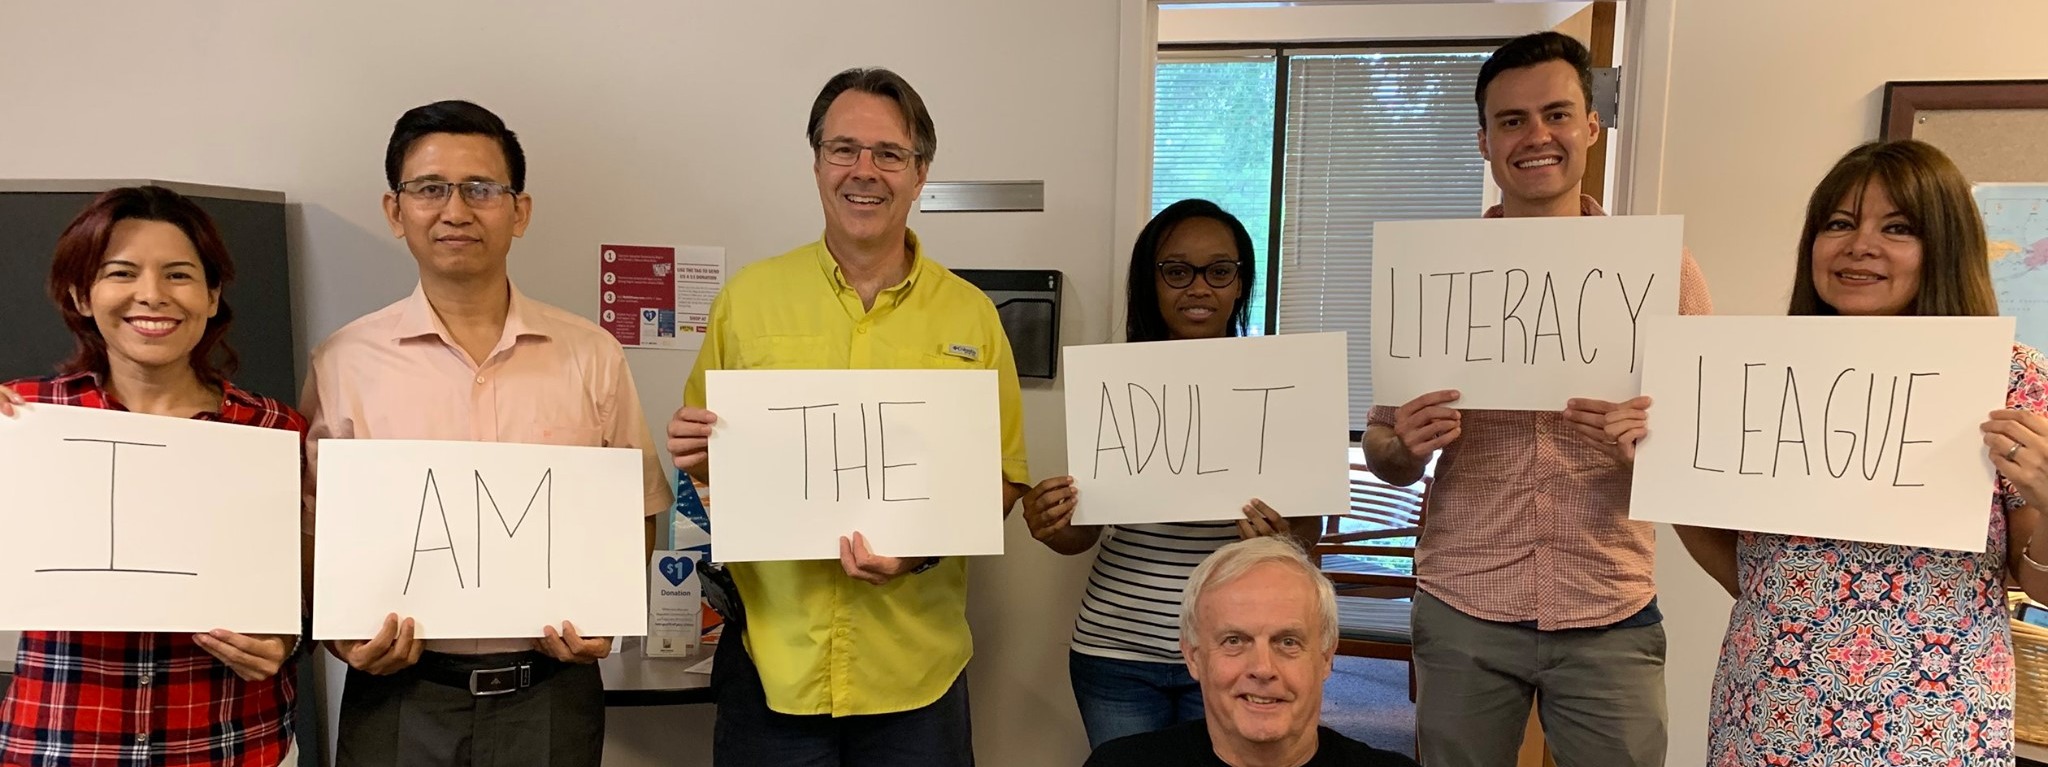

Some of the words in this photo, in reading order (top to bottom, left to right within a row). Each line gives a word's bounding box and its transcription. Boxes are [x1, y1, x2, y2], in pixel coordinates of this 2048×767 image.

[1389, 268, 1655, 373] LITERACY
[768, 402, 931, 503] THE
[1094, 382, 1296, 480] ADULT
[1693, 355, 1941, 488] LEAGUE
[35, 438, 199, 577] I
[403, 468, 552, 596] AM
[667, 561, 683, 580] $1
